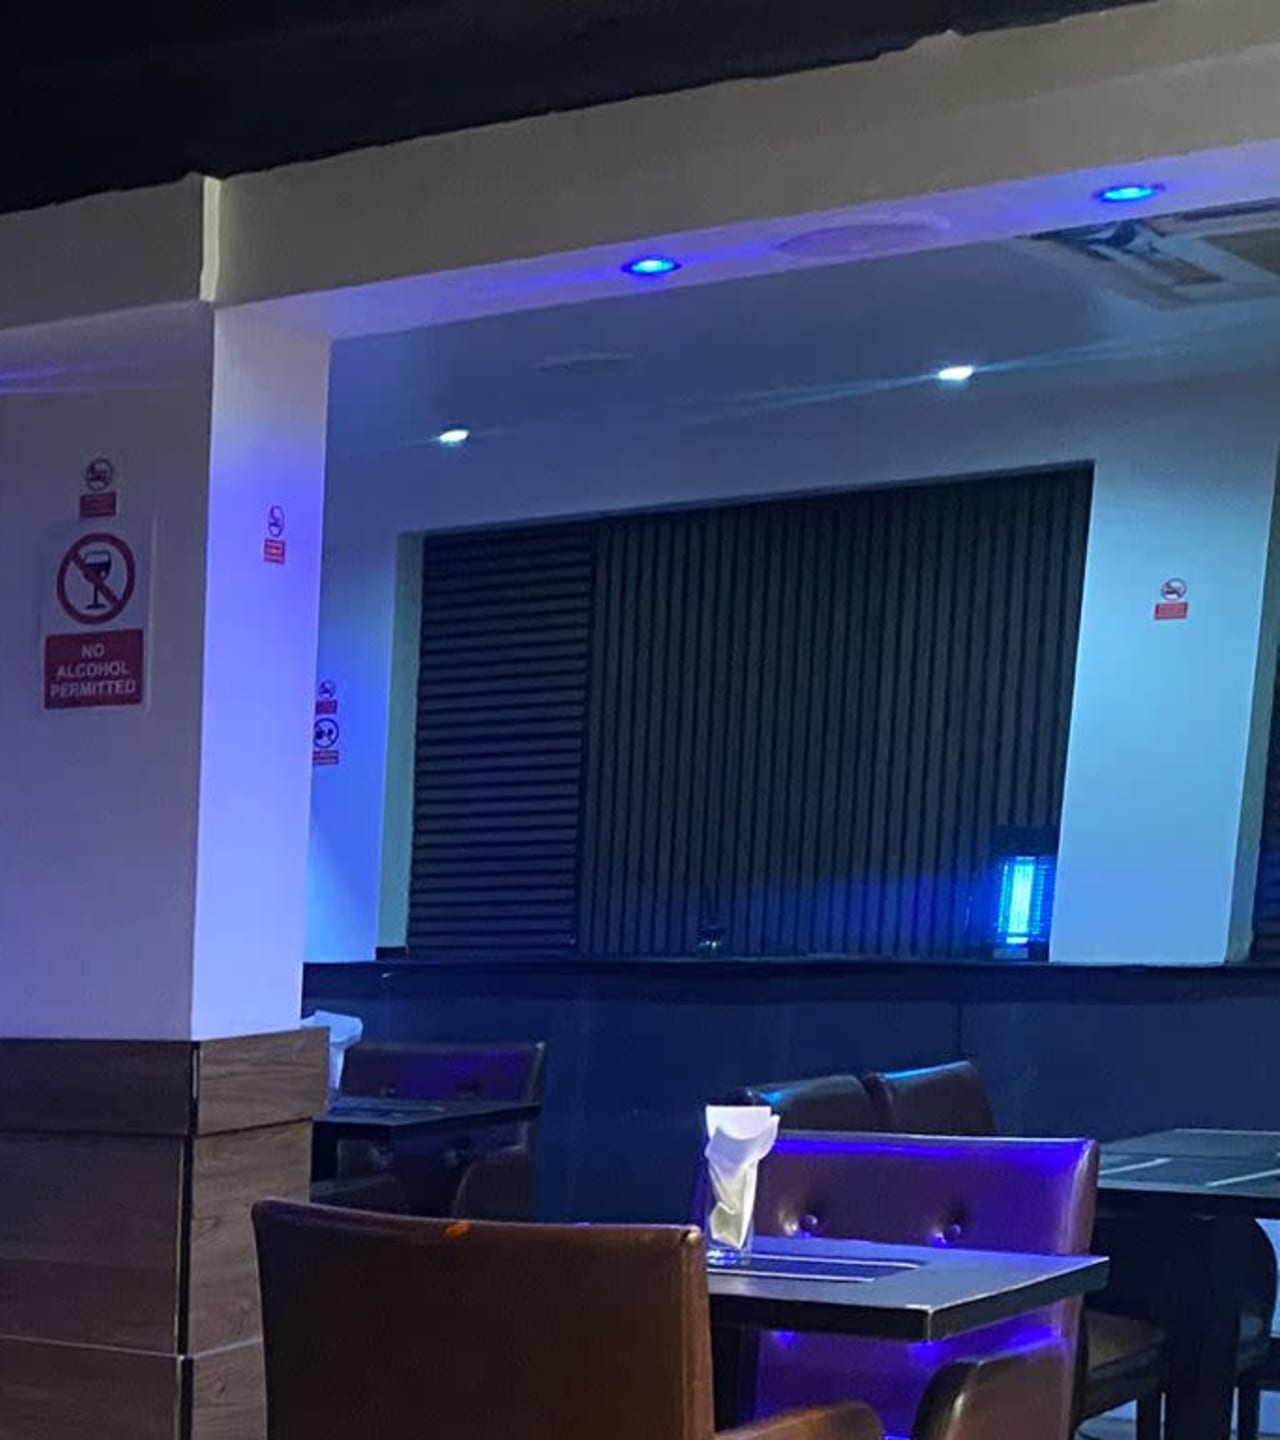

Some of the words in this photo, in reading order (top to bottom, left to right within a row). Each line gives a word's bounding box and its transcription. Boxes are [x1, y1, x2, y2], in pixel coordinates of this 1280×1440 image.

[81, 642, 105, 659] NO
[56, 660, 130, 679] ALCOHOL
[50, 679, 137, 699] PERMITTED
